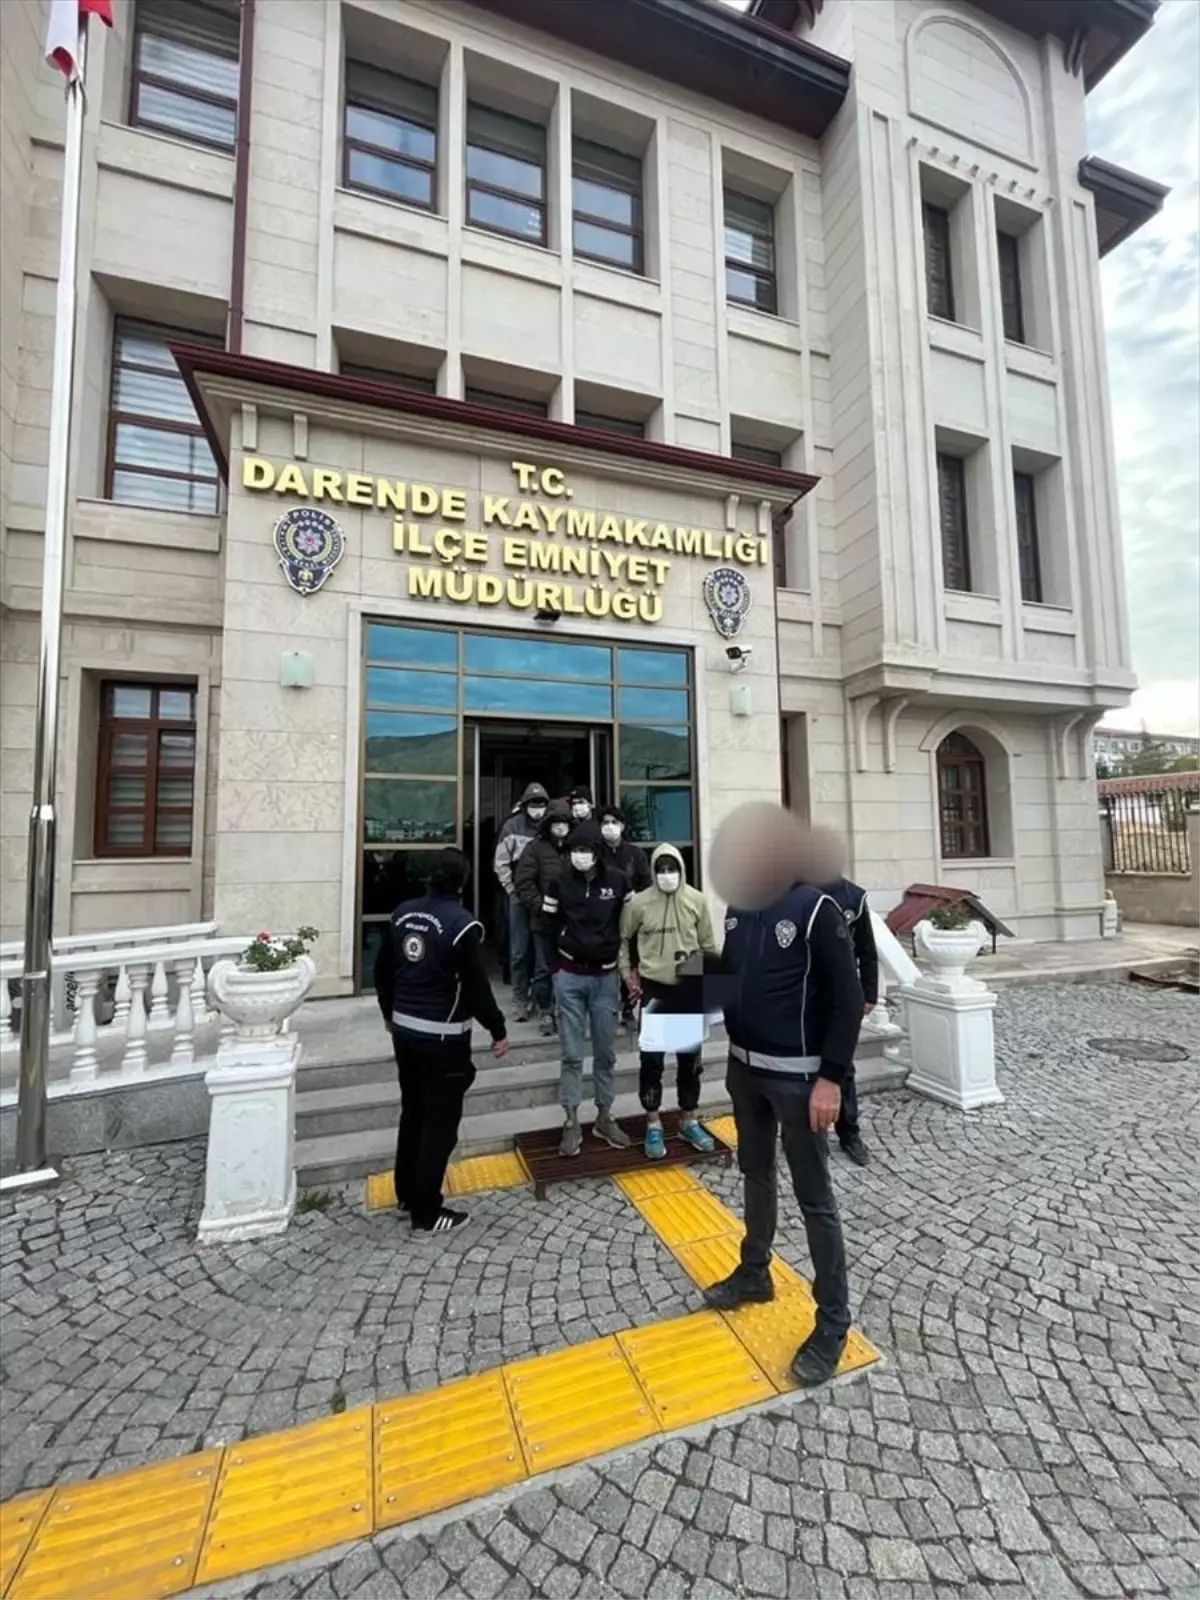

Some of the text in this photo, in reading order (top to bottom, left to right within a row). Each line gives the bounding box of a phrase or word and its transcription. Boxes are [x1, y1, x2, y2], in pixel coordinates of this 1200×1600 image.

[242, 456, 768, 564] DARENDE KAYMAKAMLIĞI
[512, 461, 574, 498] T.C.
[392, 514, 489, 563] İLÇE
[503, 536, 671, 585] EMNİYET
[408, 565, 663, 622] MÜDÜRLÜĞÜ
